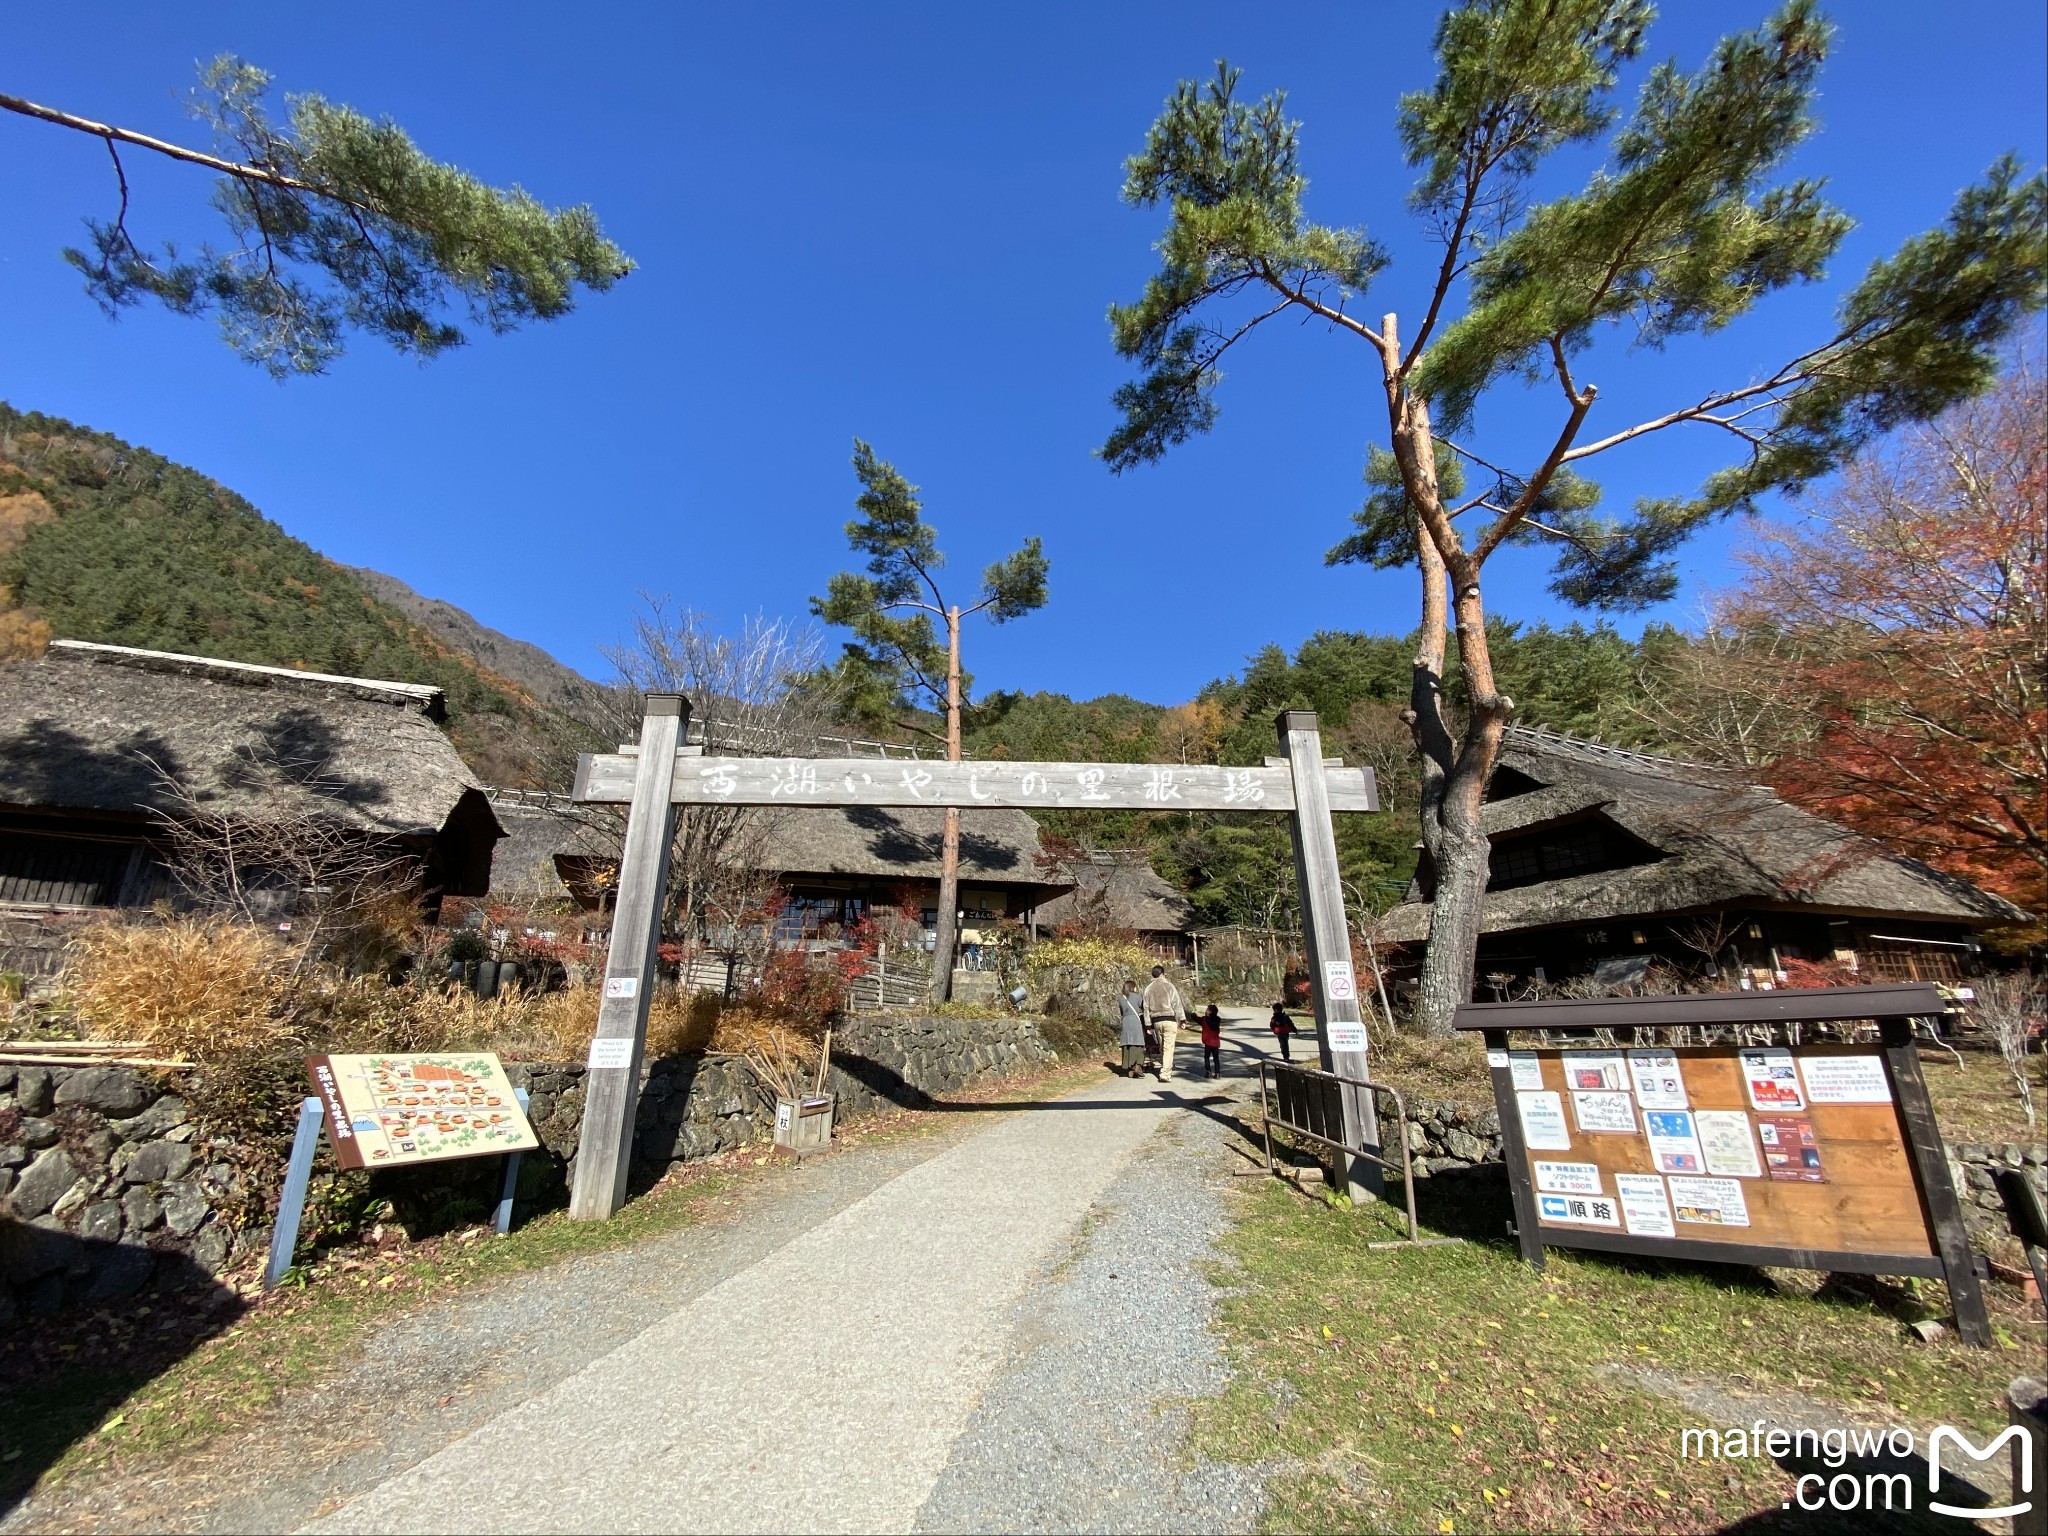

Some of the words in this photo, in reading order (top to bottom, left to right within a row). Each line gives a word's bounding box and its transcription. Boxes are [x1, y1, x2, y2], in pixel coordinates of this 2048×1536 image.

[700, 763, 1265, 803] 西湖いやしの里根場
[1568, 1200, 1612, 1221] 順路
